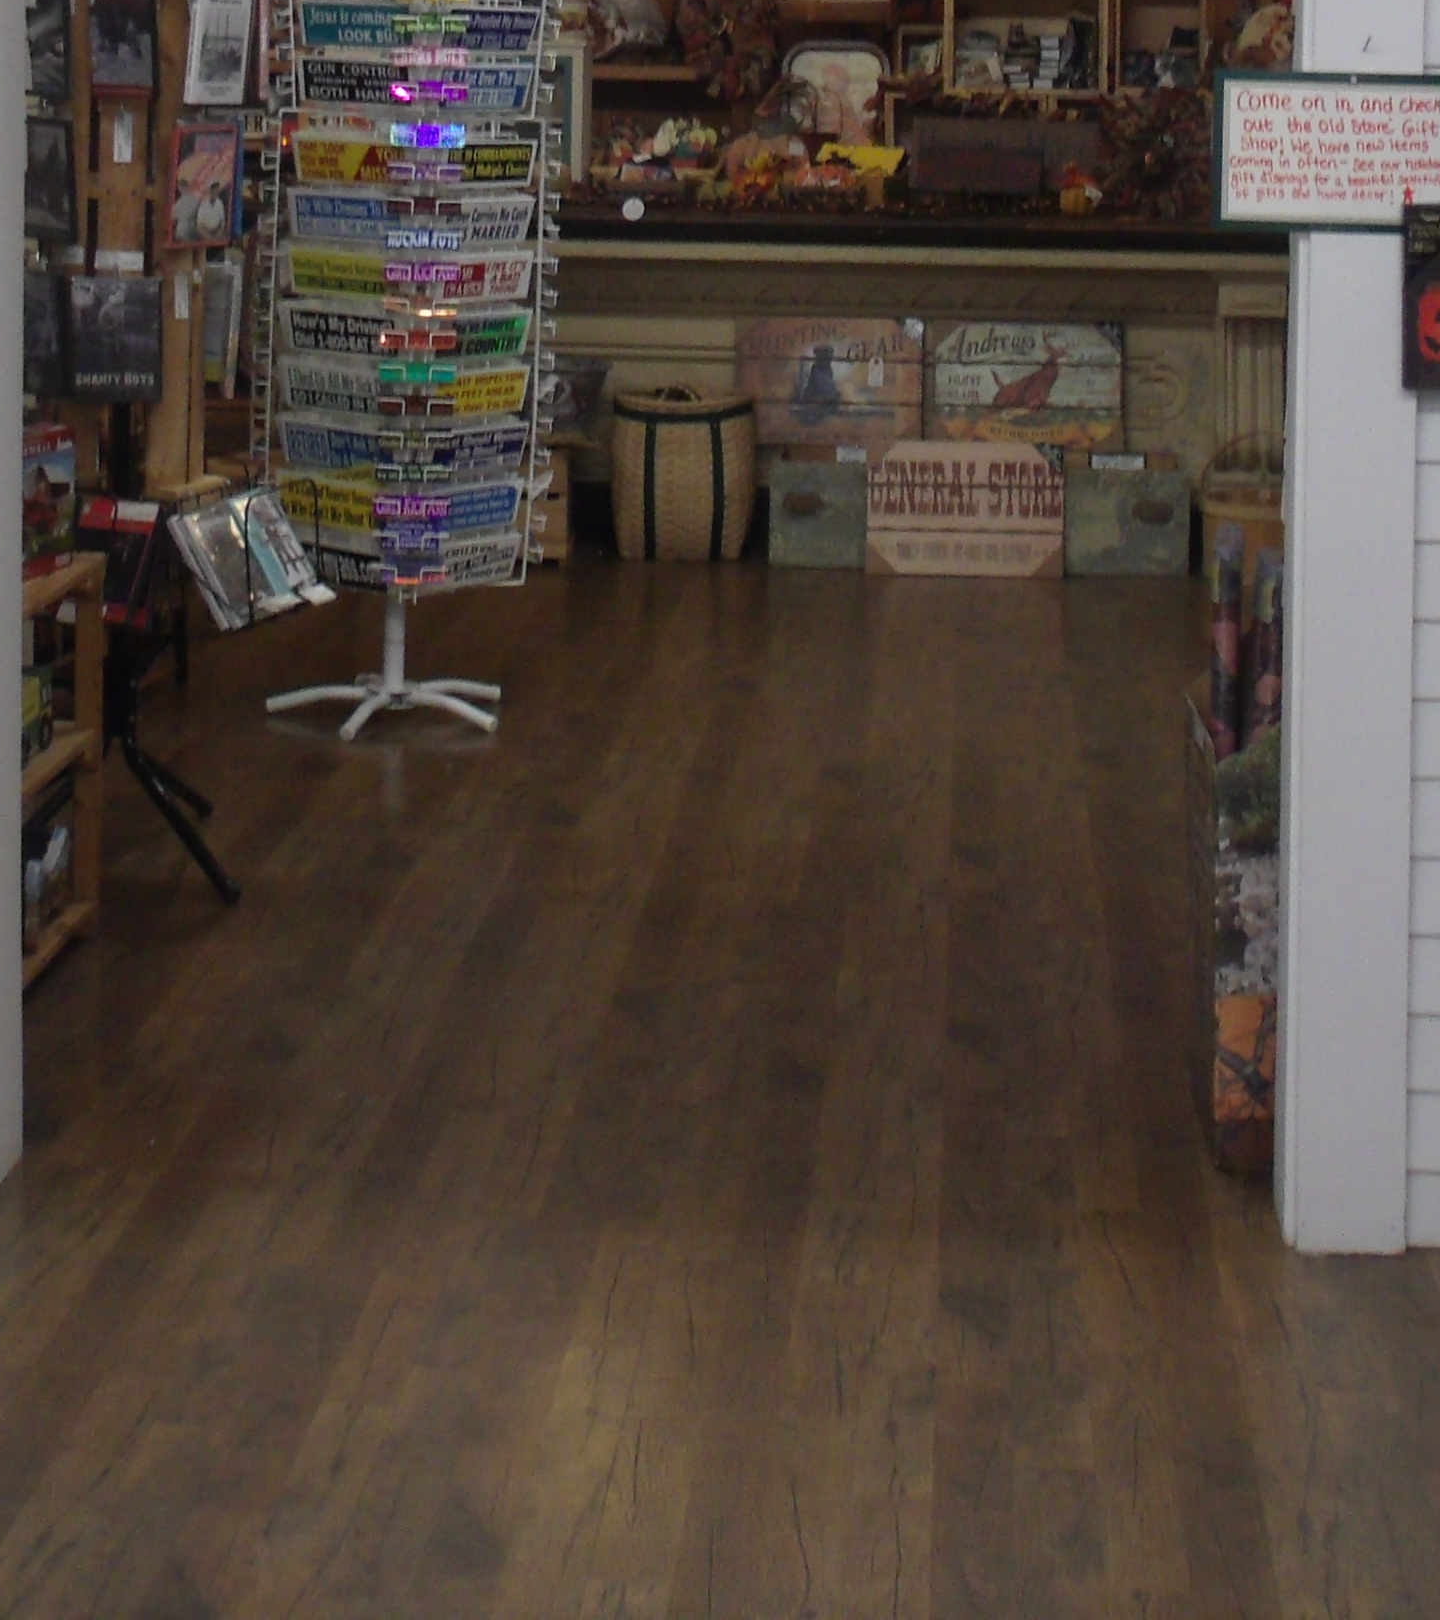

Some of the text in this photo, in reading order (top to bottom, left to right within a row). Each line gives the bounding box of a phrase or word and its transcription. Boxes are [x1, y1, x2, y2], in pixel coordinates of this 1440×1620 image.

[308, 62, 402, 79] GUN CONTROL
[310, 86, 349, 99] BOTH
[1237, 90, 1291, 112] Come
[1302, 96, 1327, 113] on
[1360, 96, 1393, 113] and
[1244, 117, 1273, 133] out
[1287, 117, 1312, 134] the
[1318, 139, 1350, 153] have
[1356, 139, 1384, 152] new
[1279, 156, 1291, 168] in
[466, 337, 521, 353] COUNTRY
[948, 326, 1036, 361] Andrews
[869, 460, 1064, 519] GENERAL STORE
